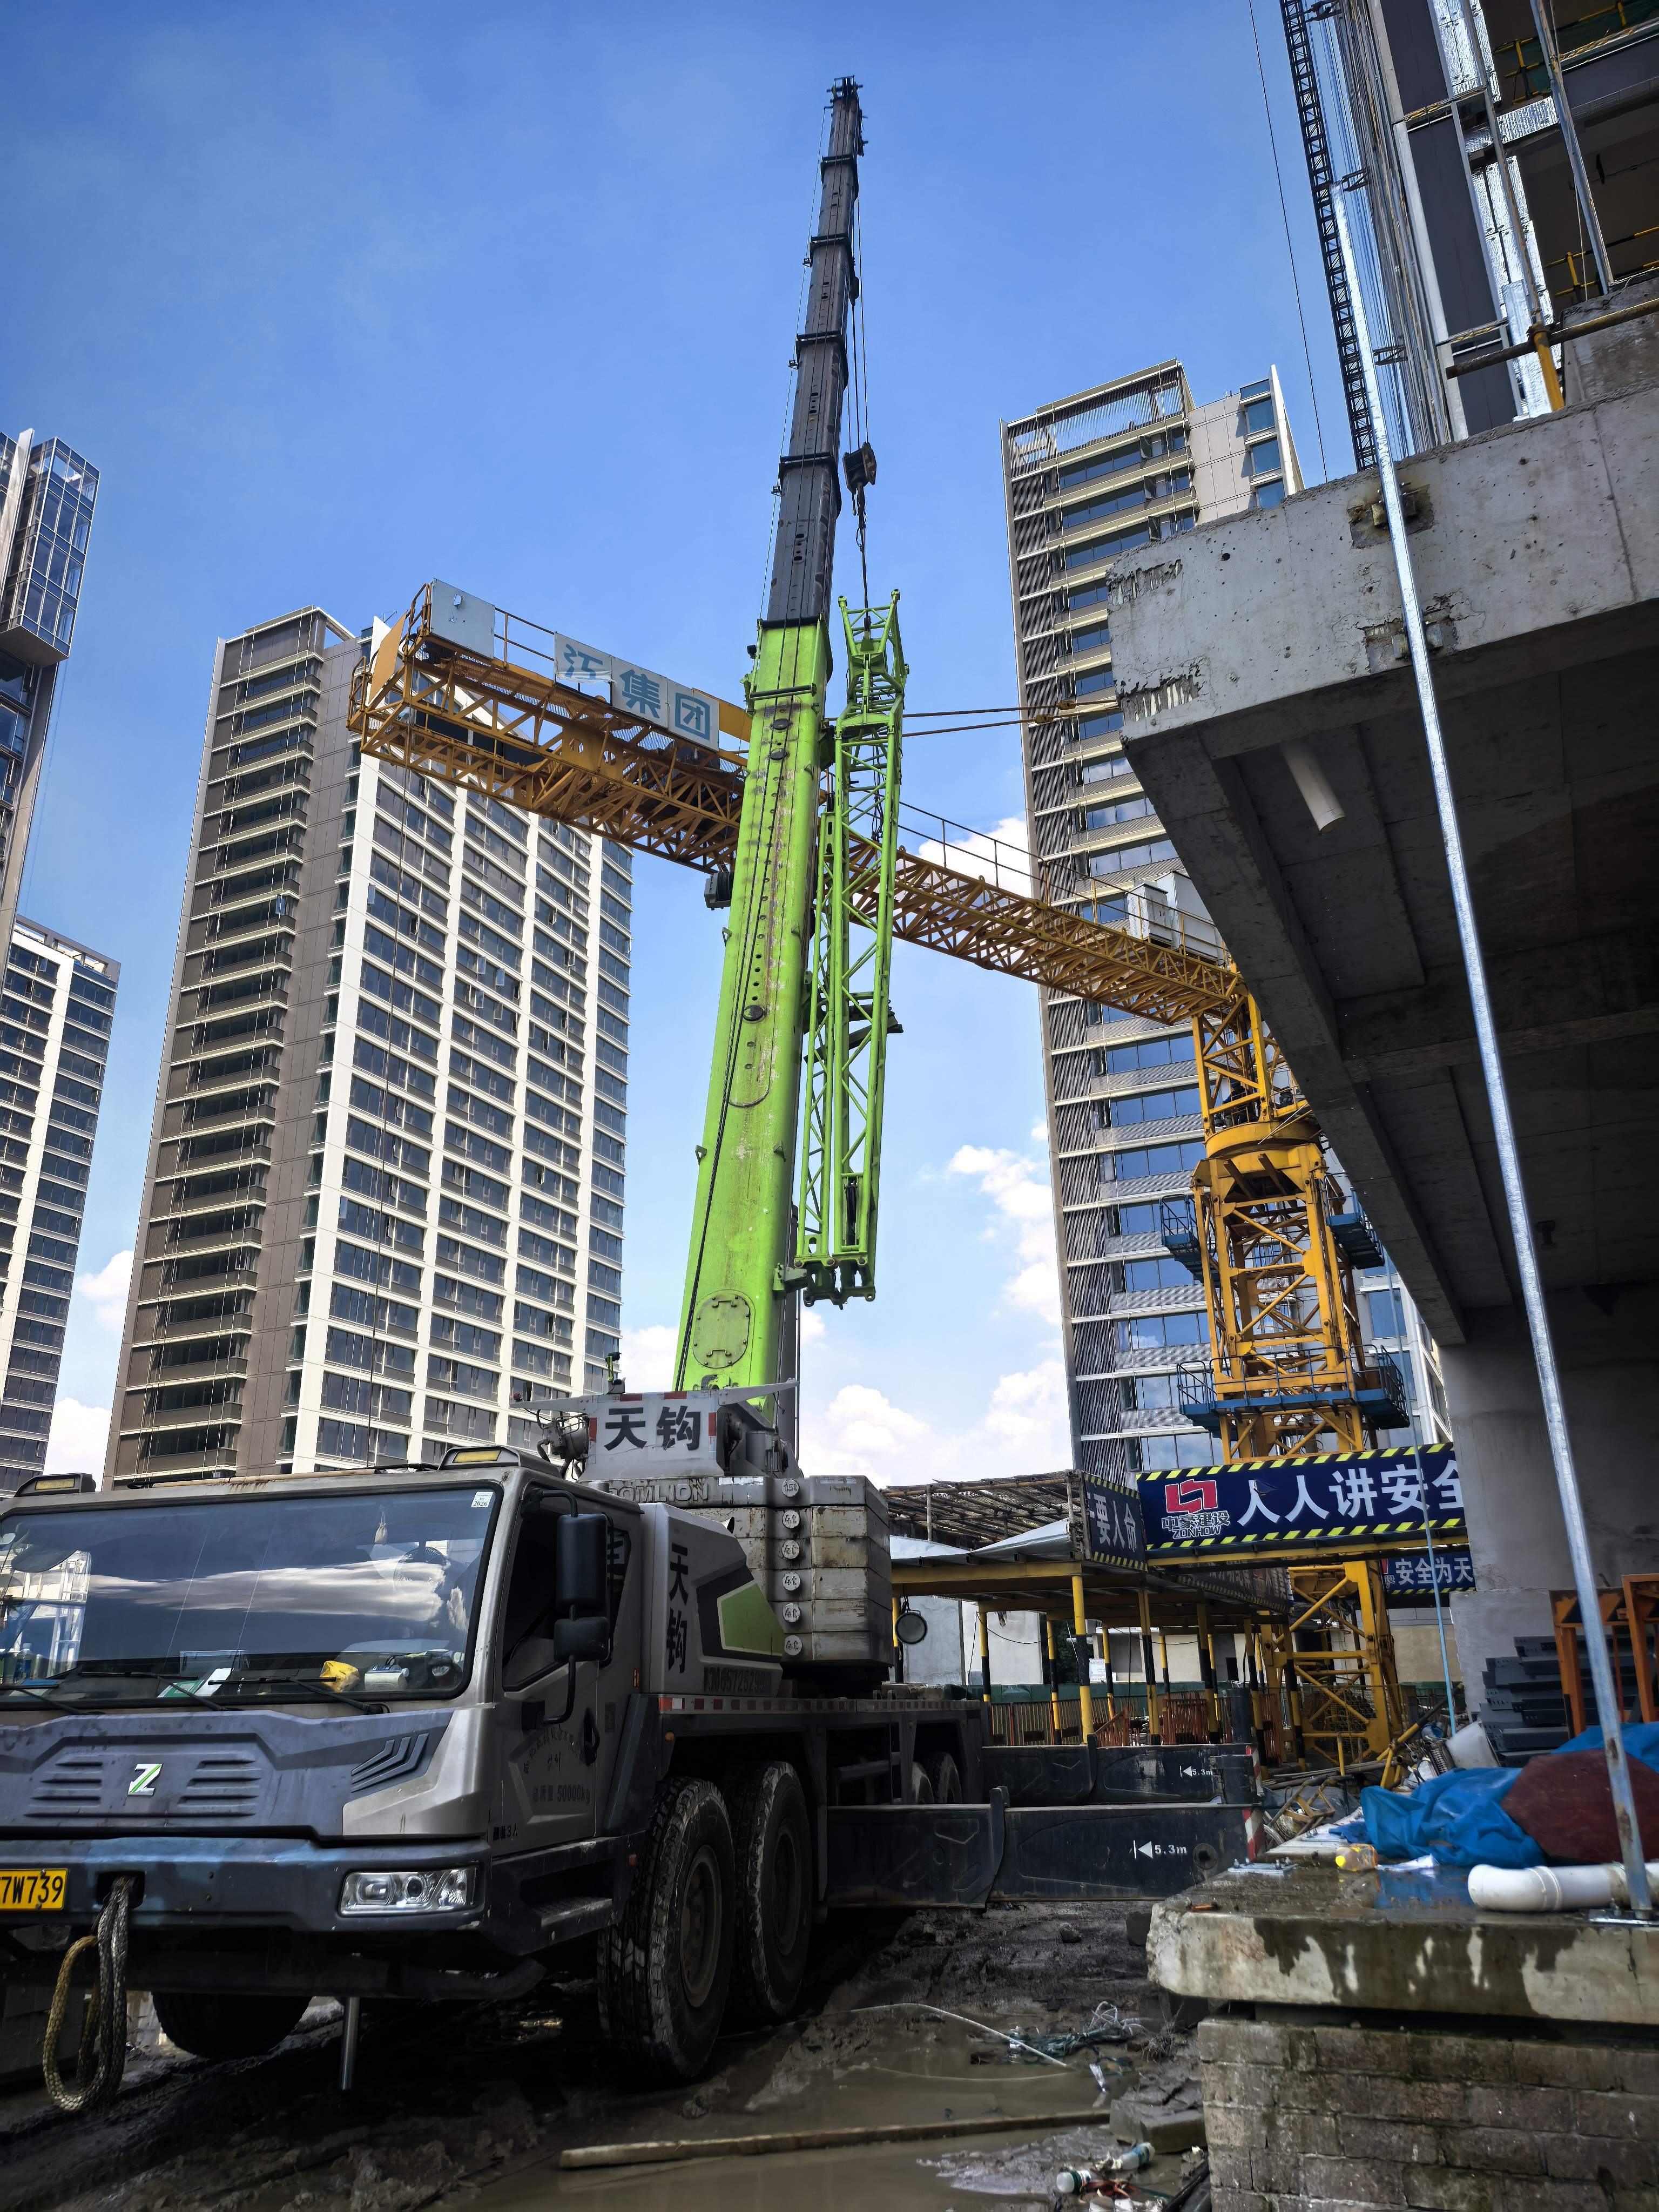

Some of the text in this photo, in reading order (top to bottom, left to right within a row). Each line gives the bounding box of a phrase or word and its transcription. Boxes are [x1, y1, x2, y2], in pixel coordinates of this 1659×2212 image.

[604, 1406, 700, 1451] 天钩
[1237, 1460, 1464, 1526] 人人讲安全
[1087, 1492, 1137, 1552] 要人命
[1162, 1510, 1230, 1531] 中豪建设
[1172, 1526, 1221, 1539] ZONHOW
[1395, 1556, 1473, 1585] 安全为天
[666, 1542, 689, 1674] 天钩
[1154, 1844, 1187, 1854] 5.3m
